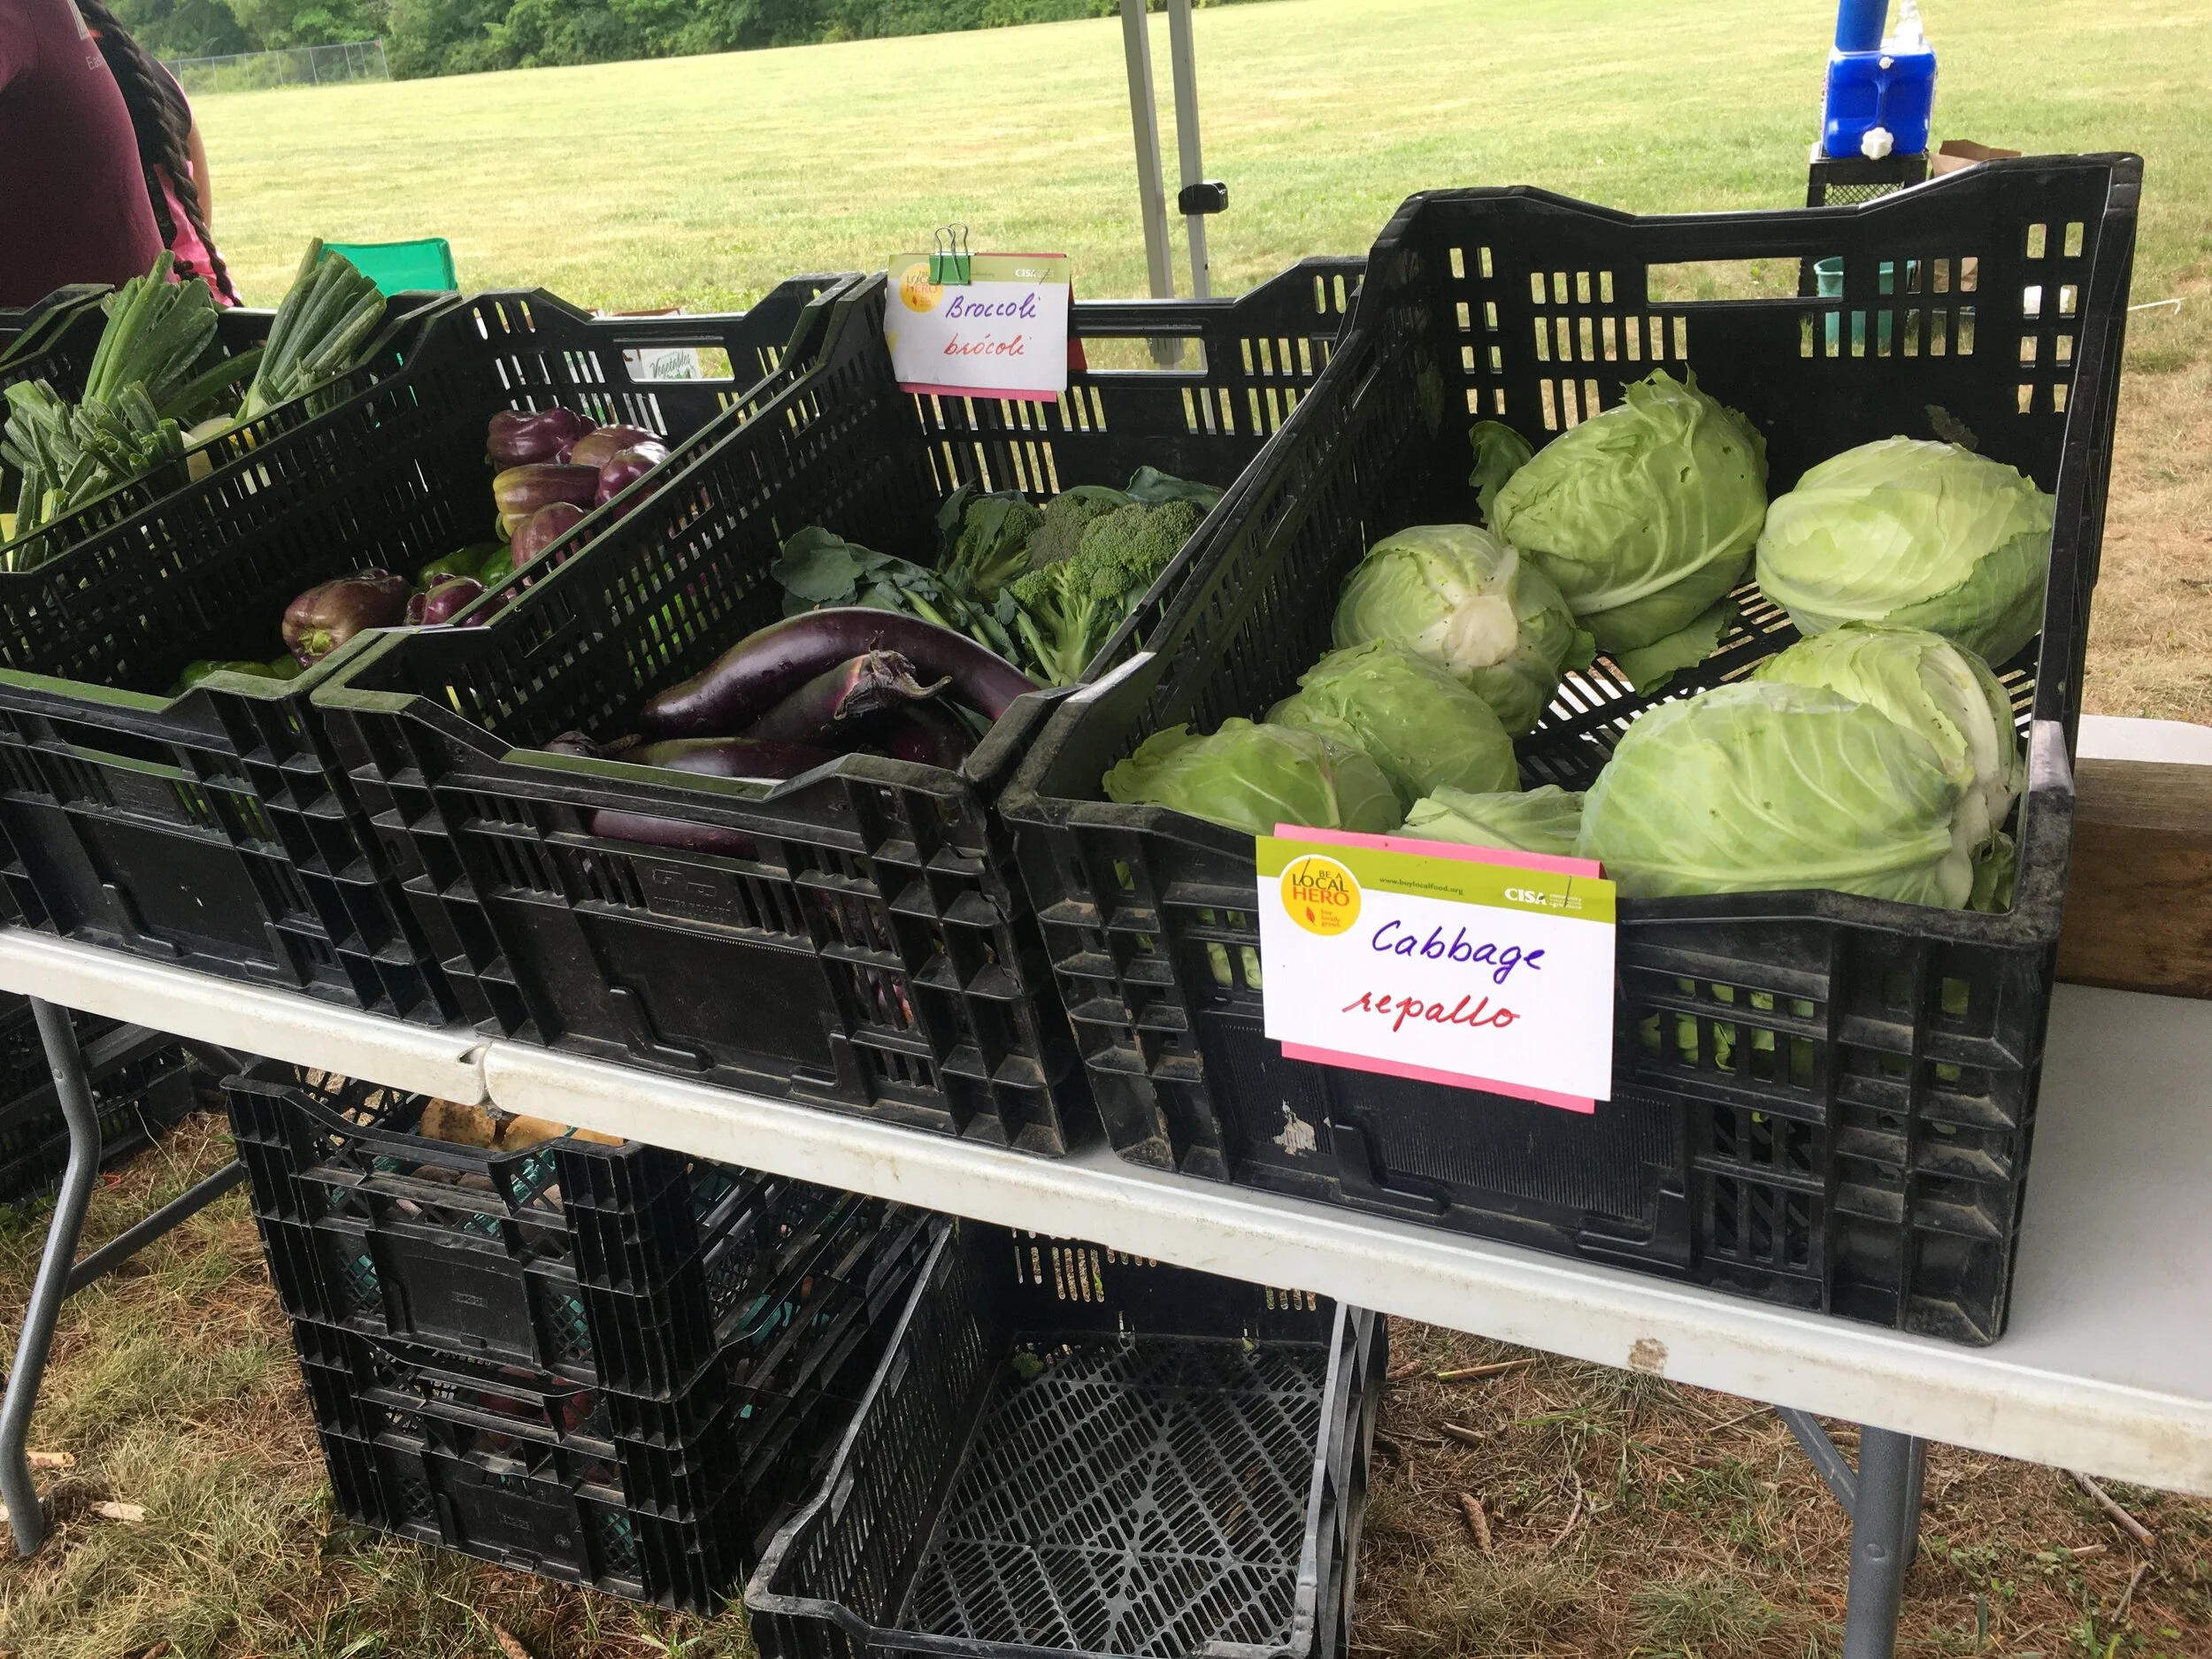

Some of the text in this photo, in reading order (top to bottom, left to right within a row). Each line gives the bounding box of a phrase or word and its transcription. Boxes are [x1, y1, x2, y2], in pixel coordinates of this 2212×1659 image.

[906, 282, 938, 294] HERO
[945, 293, 1041, 319] Broccoli
[943, 333, 1032, 356] brócoli
[649, 350, 691, 380] Vegetables
[1292, 873, 1349, 893] LOCAL
[1379, 878, 1463, 895] www.buylocalfood.org
[1293, 886, 1350, 907] HERO
[1504, 887, 1548, 906] CISA
[1372, 919, 1546, 984] Cabbage
[1341, 991, 1521, 1033] repallo
